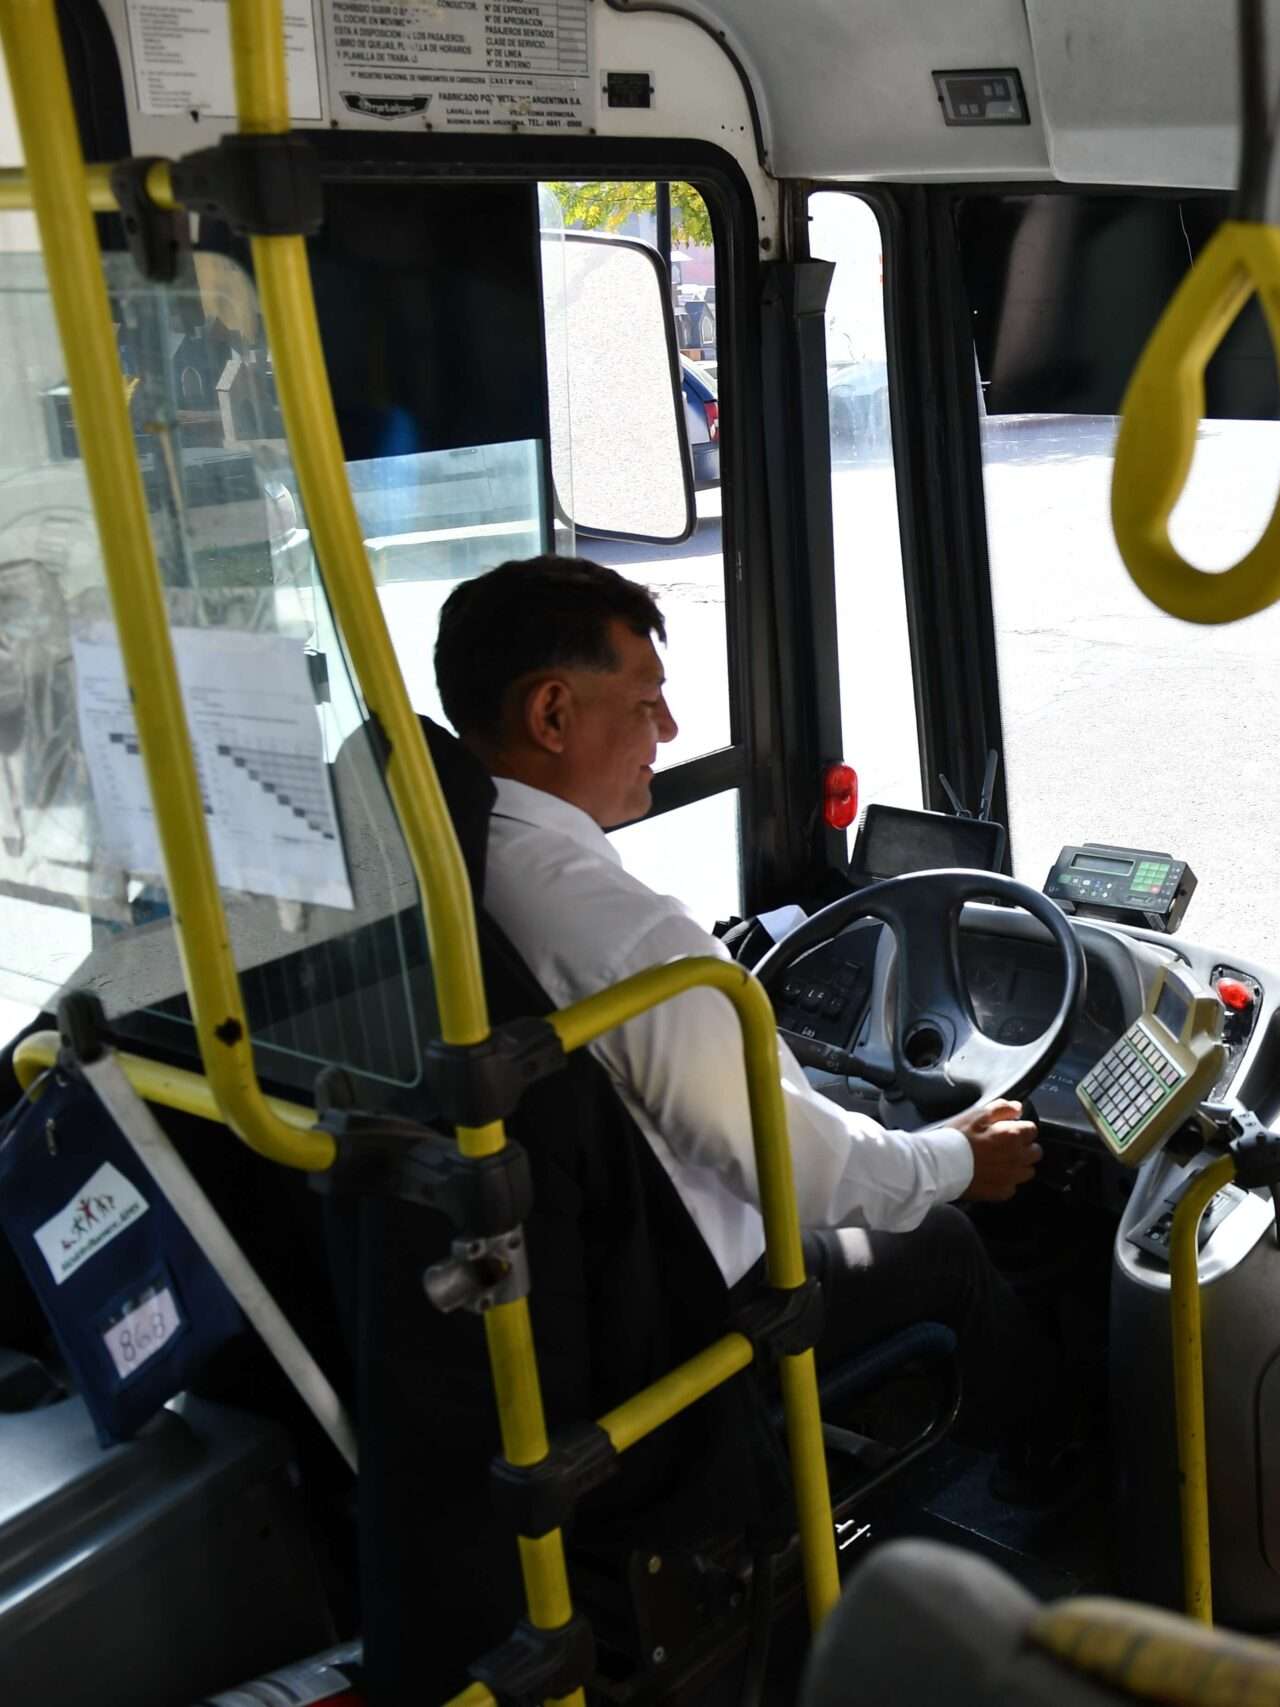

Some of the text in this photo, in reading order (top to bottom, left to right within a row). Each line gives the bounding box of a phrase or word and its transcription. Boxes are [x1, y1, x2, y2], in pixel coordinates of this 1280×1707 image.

[333, 2, 369, 13] PROHIBIDO
[371, 5, 391, 14] SUBIR
[493, 5, 501, 13] DE
[503, 6, 539, 16] EXPEDIENTE
[333, 13, 341, 23] EL
[343, 14, 367, 24] COCHE
[369, 16, 378, 25] EN
[493, 16, 501, 25] DE
[353, 27, 358, 36] A
[412, 31, 425, 41] LOS
[485, 25, 554, 39] PASAJEROS SENTADOS
[335, 38, 355, 48] LIBRO
[357, 39, 366, 48] DE
[429, 43, 438, 53] DE
[486, 37, 546, 49] CLASE DE SERVICIO
[343, 50, 375, 61] PLANILLA
[376, 52, 385, 61] DE
[494, 48, 502, 57] DE
[495, 60, 502, 69] DE
[504, 60, 531, 69] INTERNO
[438, 92, 480, 102] FABRICADO
[532, 96, 568, 105] ARGENTINA
